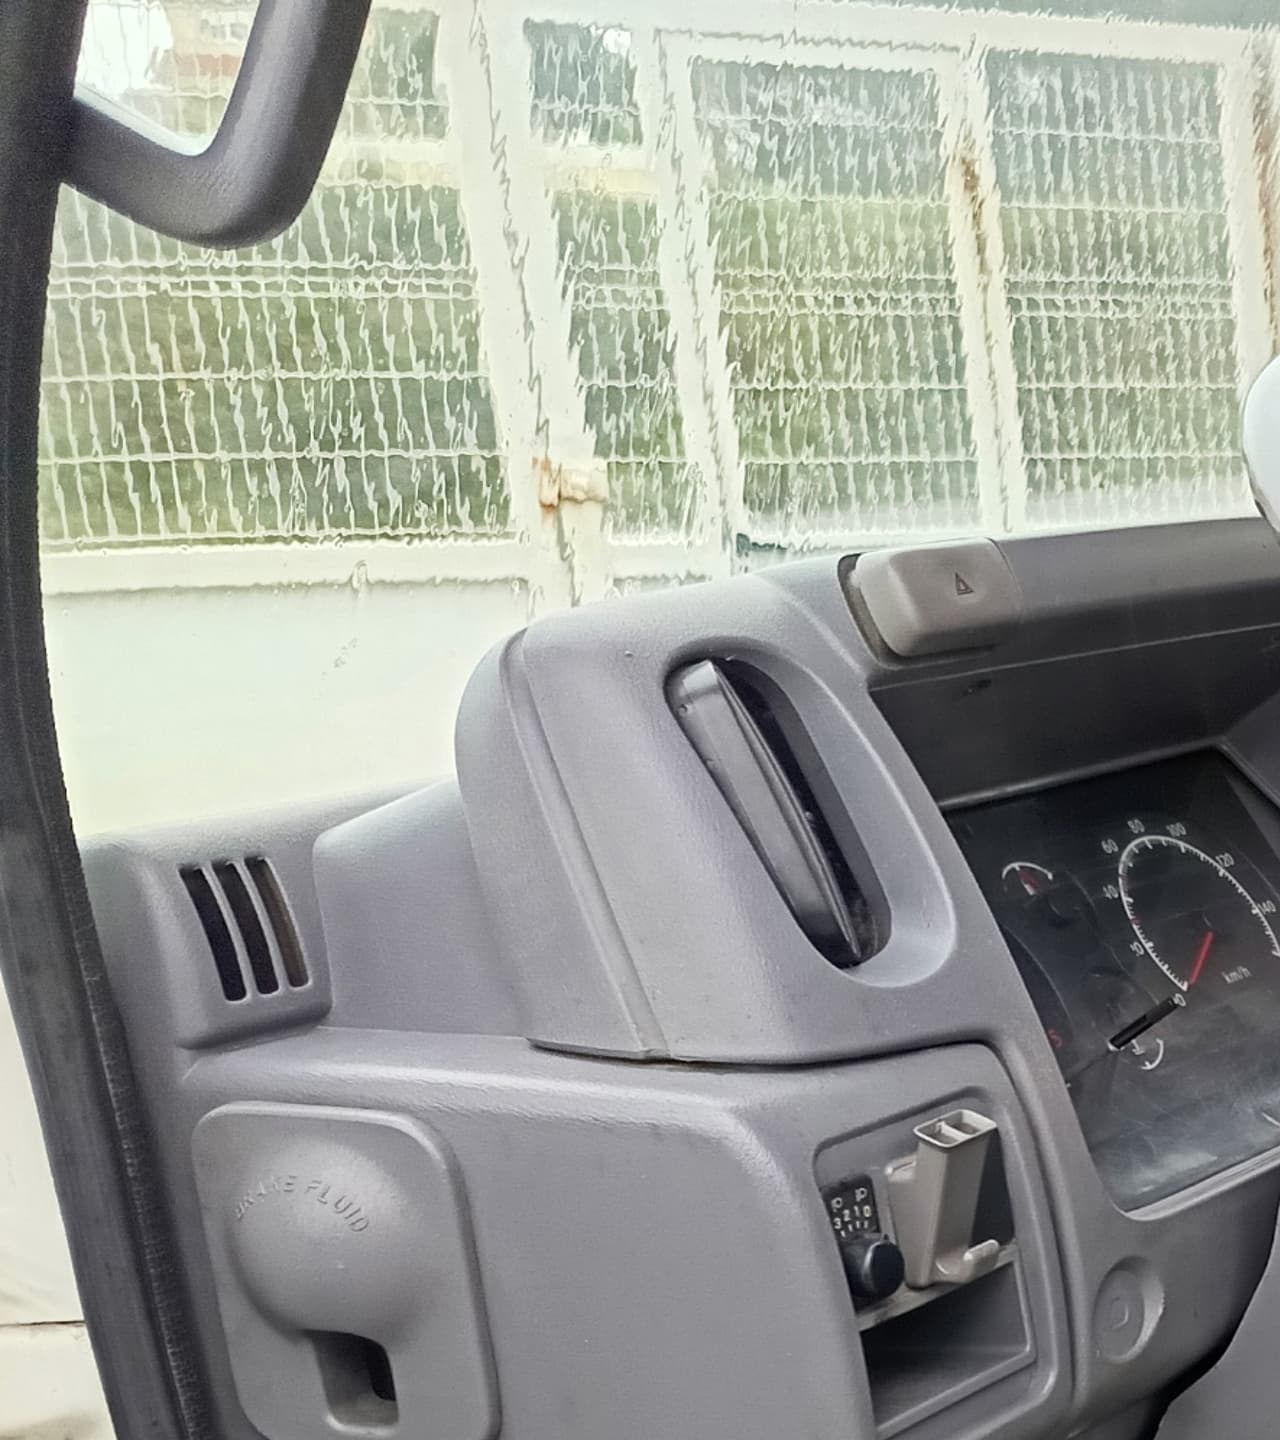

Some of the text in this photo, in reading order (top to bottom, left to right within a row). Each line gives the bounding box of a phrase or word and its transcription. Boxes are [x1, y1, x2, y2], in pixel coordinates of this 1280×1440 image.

[1166, 822, 1187, 837] 100
[1101, 838, 1119, 854] 60
[1216, 852, 1235, 868] 120
[1257, 899, 1277, 914] 140
[1221, 965, 1251, 984] km/h
[304, 1179, 370, 1233] FLUID
